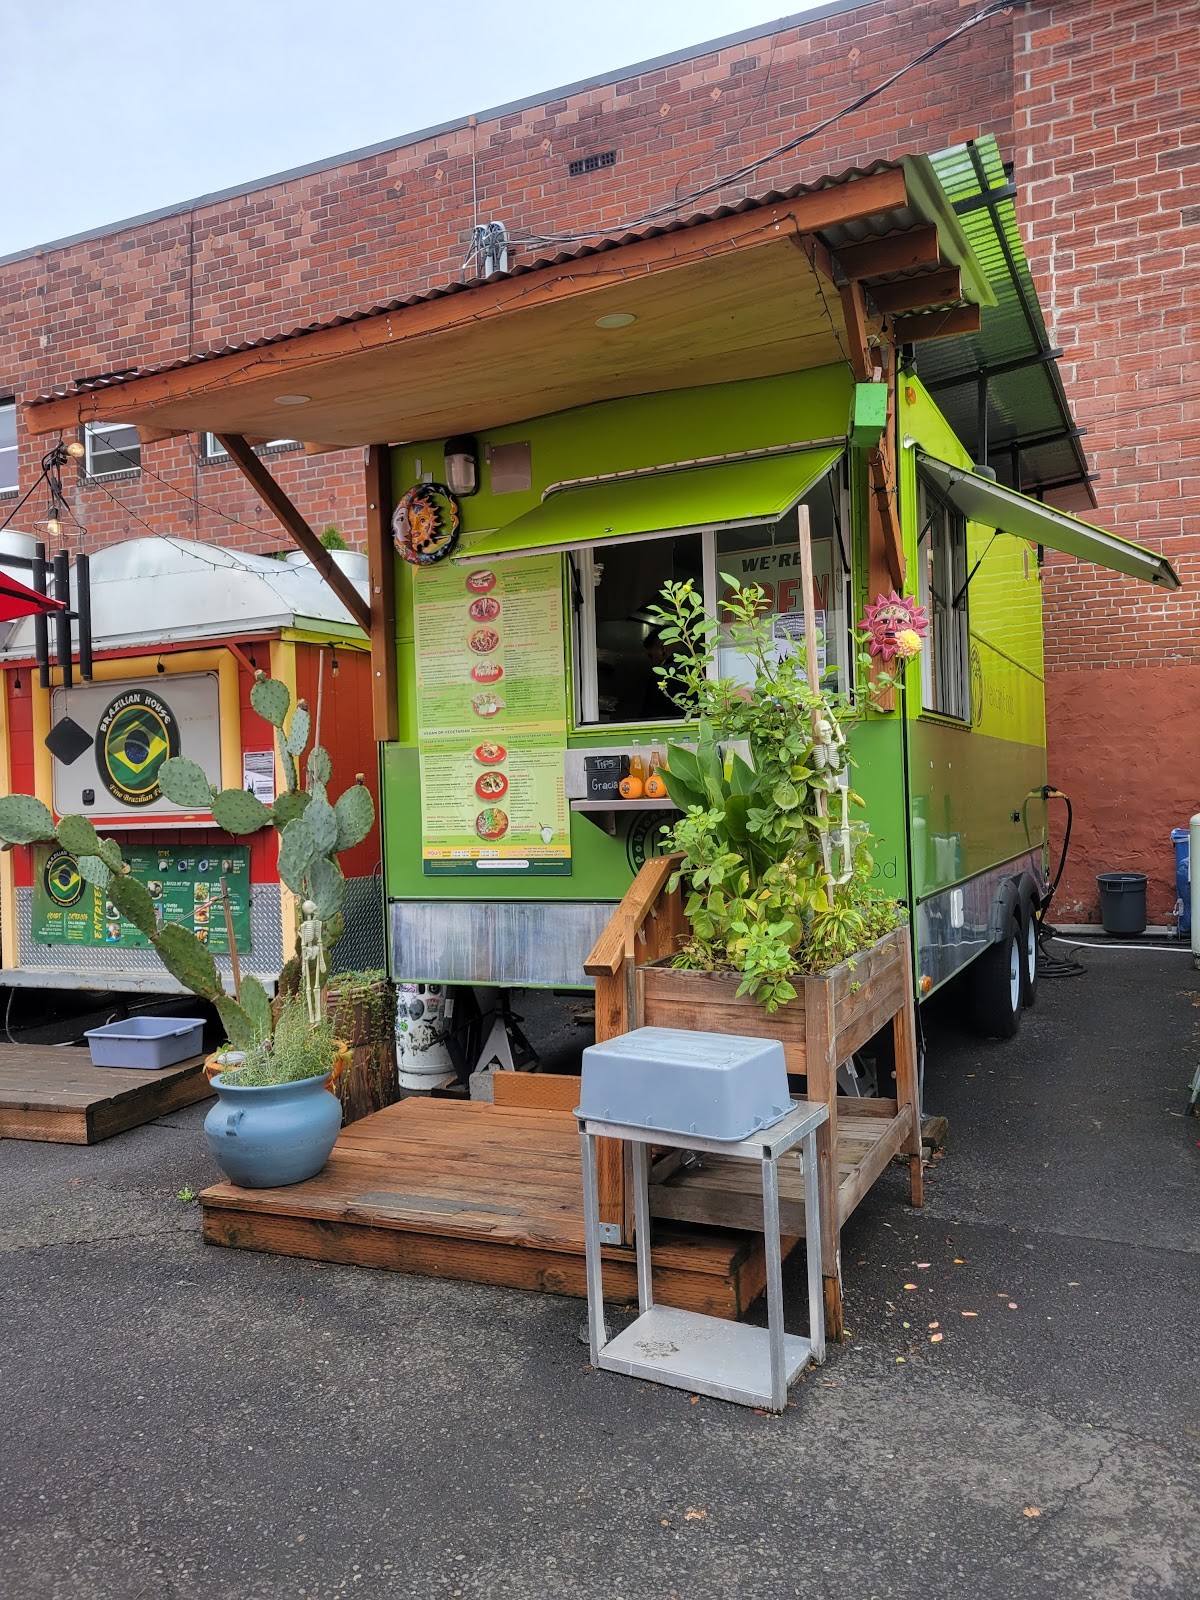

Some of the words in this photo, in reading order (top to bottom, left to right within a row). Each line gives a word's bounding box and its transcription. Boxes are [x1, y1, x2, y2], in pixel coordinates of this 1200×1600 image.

[742, 551, 802, 573] WE'RE
[100, 694, 140, 732] BRAZILIAN
[144, 696, 171, 724] HOUSE
[109, 784, 123, 799] Fine
[123, 793, 153, 803] Brazilian
[591, 778, 619, 790] Gracia
